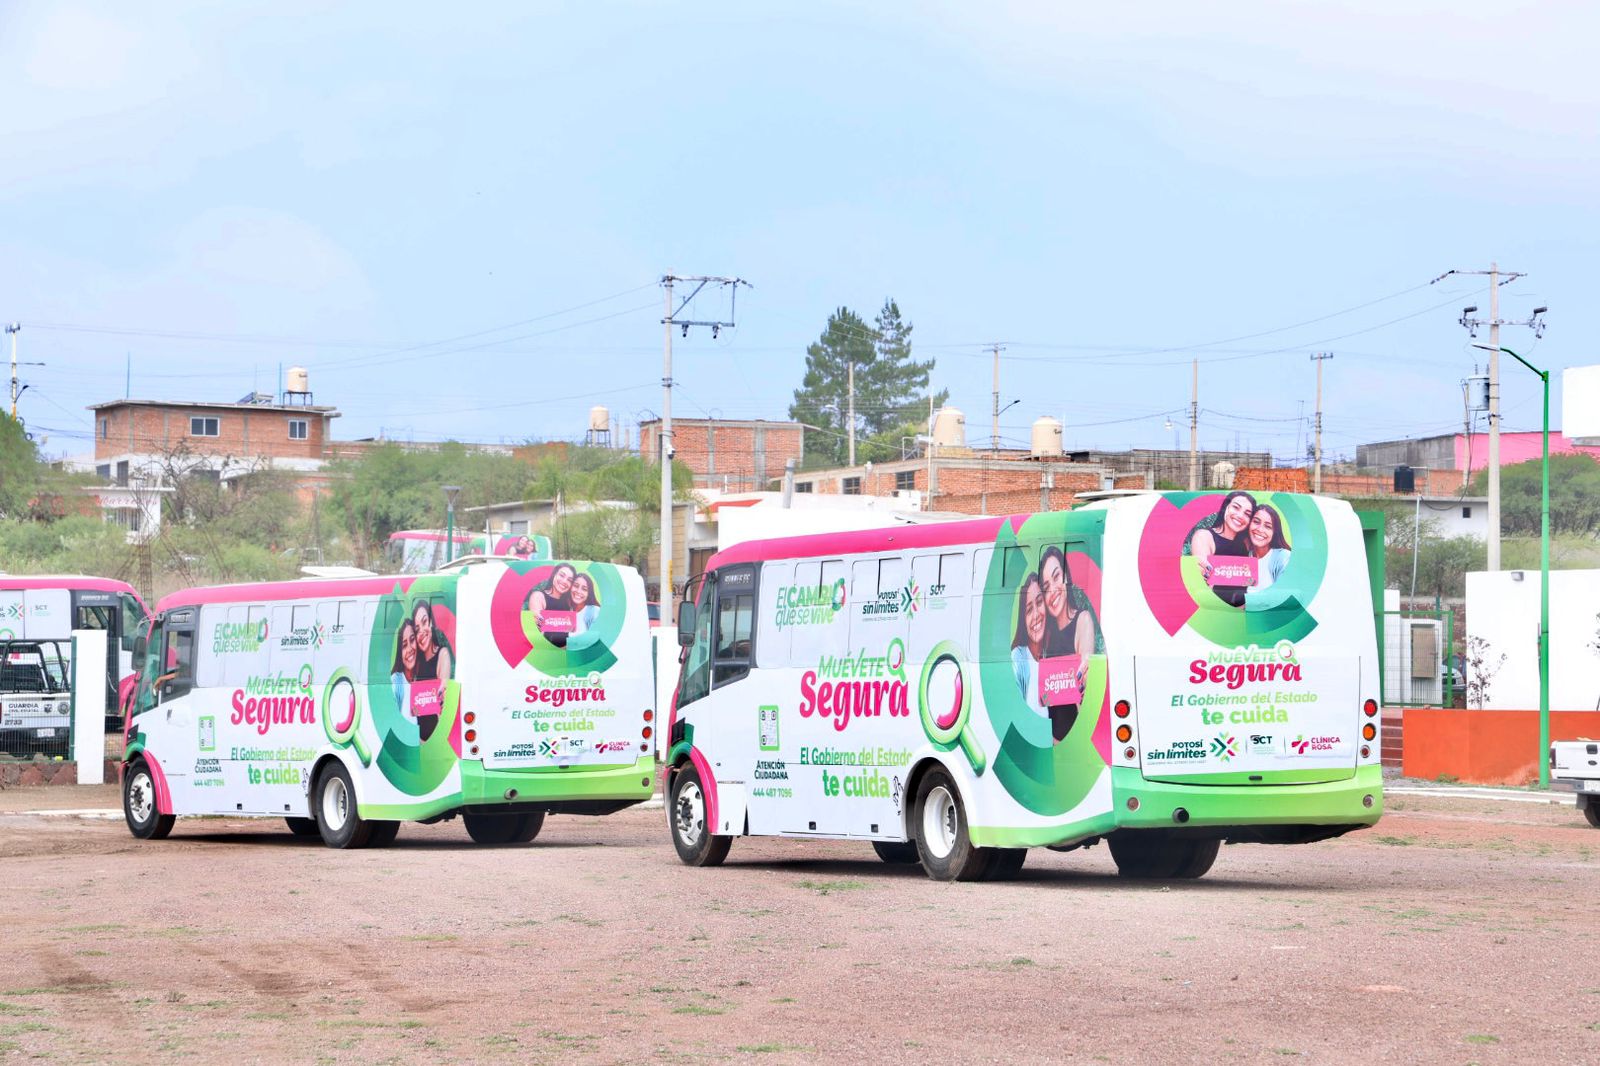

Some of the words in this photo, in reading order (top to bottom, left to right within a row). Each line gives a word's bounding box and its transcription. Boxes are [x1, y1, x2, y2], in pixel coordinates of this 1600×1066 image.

[862, 601, 874, 614] sin
[775, 608, 797, 633] que
[797, 608, 810, 625] se
[811, 607, 834, 625] vive
[818, 648, 885, 678] MUÉVETE
[1209, 649, 1276, 663] MUÉVETE
[1190, 659, 1302, 689] Segura
[246, 671, 298, 696] MUÉVETE
[525, 686, 605, 706] Segura
[799, 670, 910, 732] Segura
[1171, 695, 1184, 707] El
[1187, 692, 1248, 706] Gobierno
[1250, 691, 1272, 704] del
[1274, 690, 1318, 704] Estado
[231, 689, 316, 735] Segura
[512, 711, 521, 719] El
[523, 709, 567, 719] Gobierno
[568, 708, 584, 718] del
[586, 708, 616, 718] Estado
[1201, 708, 1225, 725] te
[1229, 705, 1289, 724] cuida
[533, 721, 550, 733] te
[553, 719, 594, 732] cuida
[1172, 739, 1203, 748] POTOSÍ
[1252, 735, 1273, 744] SCT
[231, 747, 239, 760] El
[240, 747, 274, 760] Gobierno
[276, 747, 289, 761] del
[493, 750, 507, 758] sin
[800, 747, 809, 765] El
[811, 747, 857, 765] Gobierno
[858, 747, 875, 765] del
[1147, 749, 1165, 760] sin
[248, 764, 261, 784] te
[264, 764, 300, 785] cuida
[822, 769, 839, 797] te
[843, 768, 890, 798] cuida
[753, 788, 765, 797] 444
